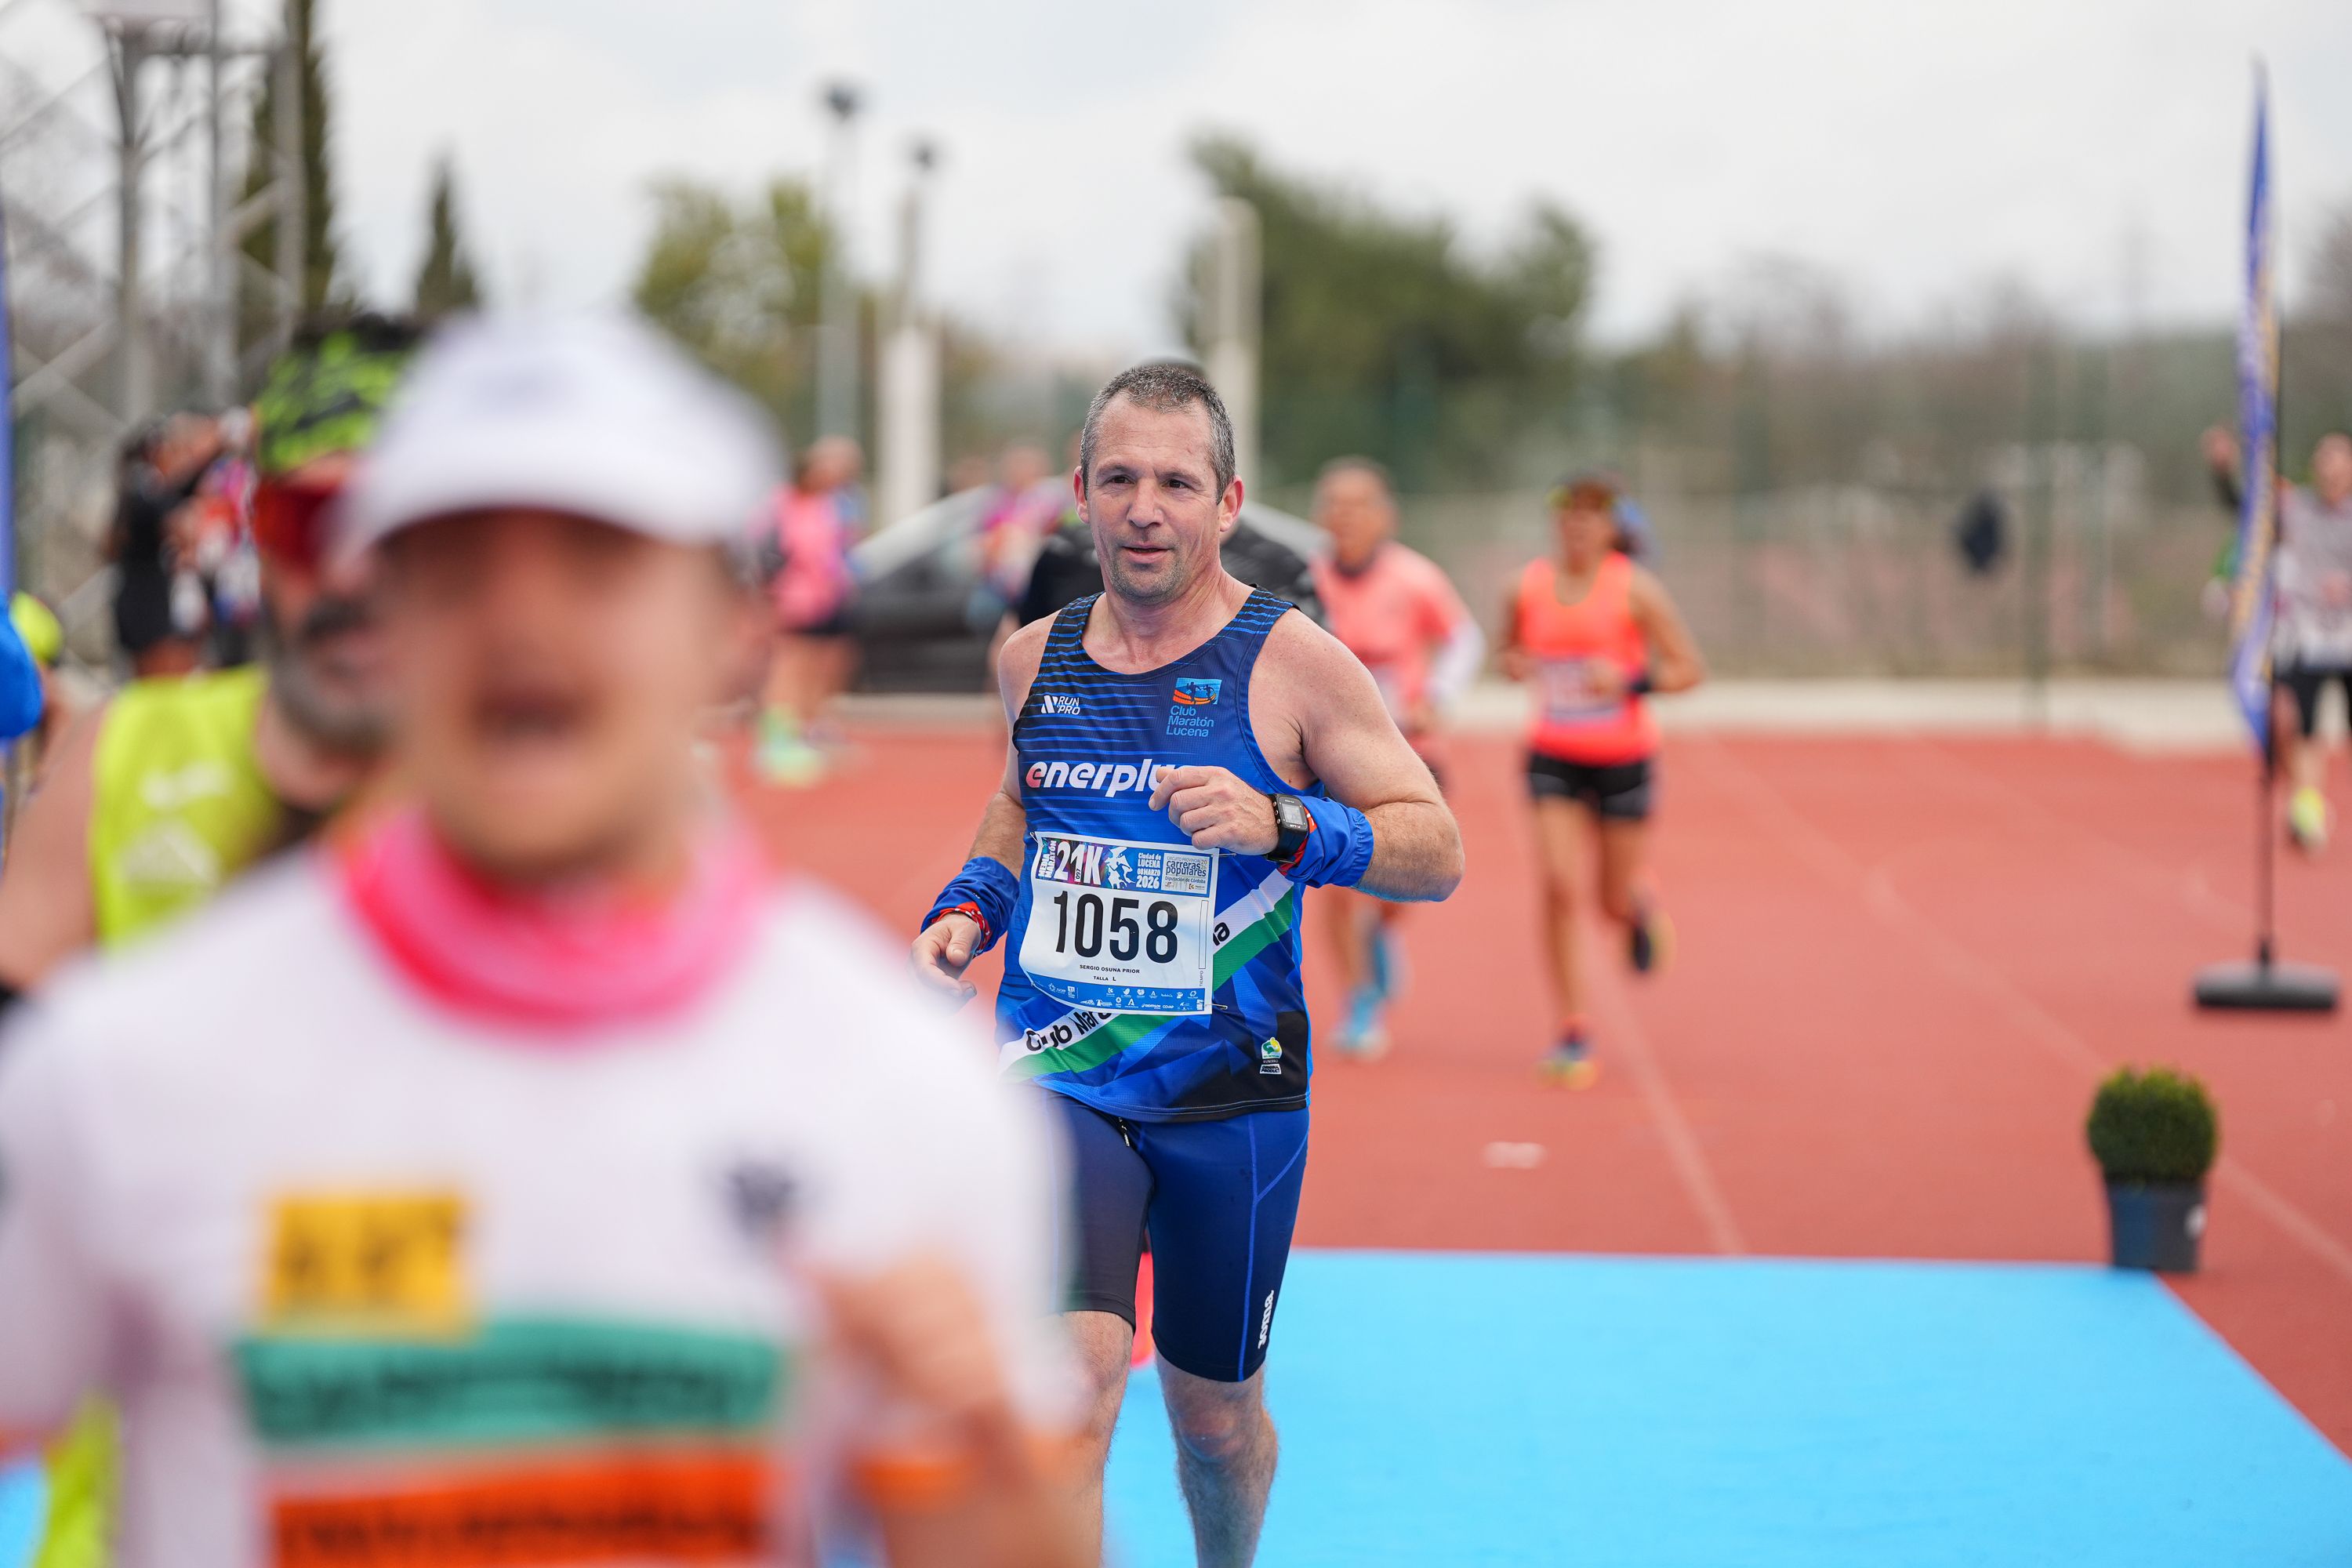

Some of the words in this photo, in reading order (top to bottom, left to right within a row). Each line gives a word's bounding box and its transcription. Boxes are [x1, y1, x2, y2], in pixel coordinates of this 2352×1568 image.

[1058, 696, 1079, 706] RUN
[1171, 706, 1196, 716] Club
[1167, 716, 1214, 727] Maratón
[1166, 725, 1209, 737] Lucena
[1025, 759, 1191, 797] enerplu
[1045, 840, 1057, 878] MARATÓN
[1054, 840, 1103, 884] 21K
[1138, 859, 1161, 869] LUCENA
[1166, 860, 1201, 870] carreras
[1038, 854, 1050, 877] MEDIA
[1165, 866, 1207, 877] populares
[1136, 875, 1160, 889] 2026
[1054, 891, 1178, 963] 1058
